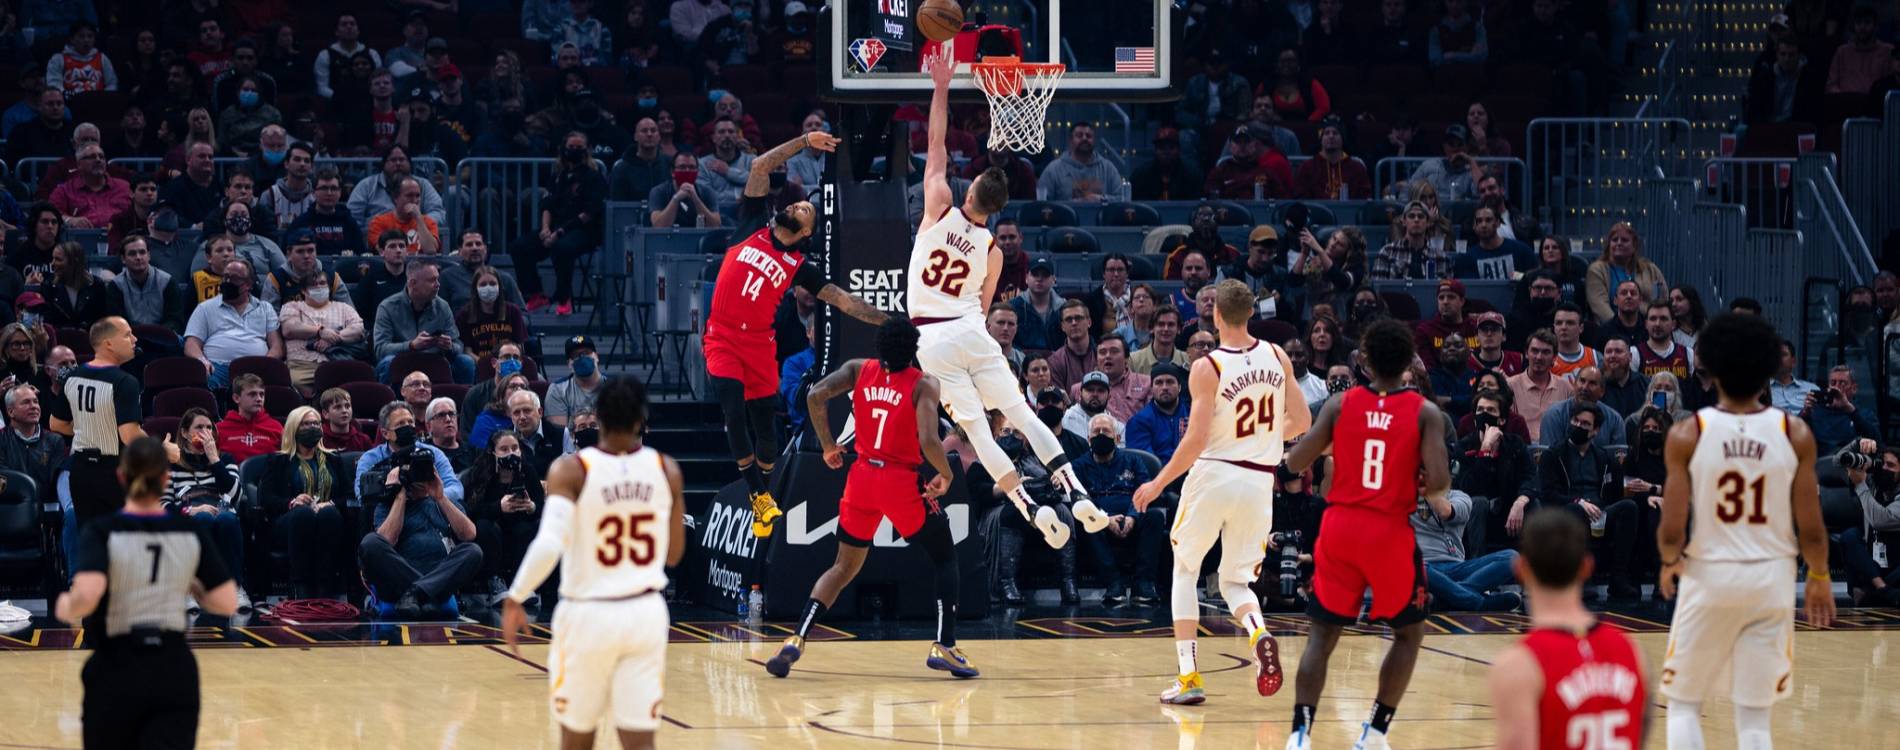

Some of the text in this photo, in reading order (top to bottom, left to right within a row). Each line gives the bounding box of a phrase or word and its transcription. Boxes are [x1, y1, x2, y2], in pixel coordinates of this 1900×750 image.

[884, 18, 904, 39] Mortgage
[946, 230, 976, 257] WADE
[736, 245, 788, 290] ROCKETS
[849, 269, 904, 291] SEAT
[921, 249, 970, 298] 32
[741, 271, 765, 302] 14
[849, 290, 905, 313] EEK
[820, 321, 833, 376] Clinic
[77, 384, 96, 413] 10
[864, 385, 903, 407] BROOKS
[872, 407, 889, 450] 7
[1236, 392, 1275, 439] 24
[1365, 410, 1394, 431] TATE
[1362, 438, 1386, 490] 8
[1722, 440, 1767, 461] ALLEN
[601, 480, 654, 505] OKORO
[1716, 470, 1767, 524] 31
[596, 512, 656, 568] 35
[146, 544, 162, 585] 7
[708, 557, 742, 600] Mortgage
